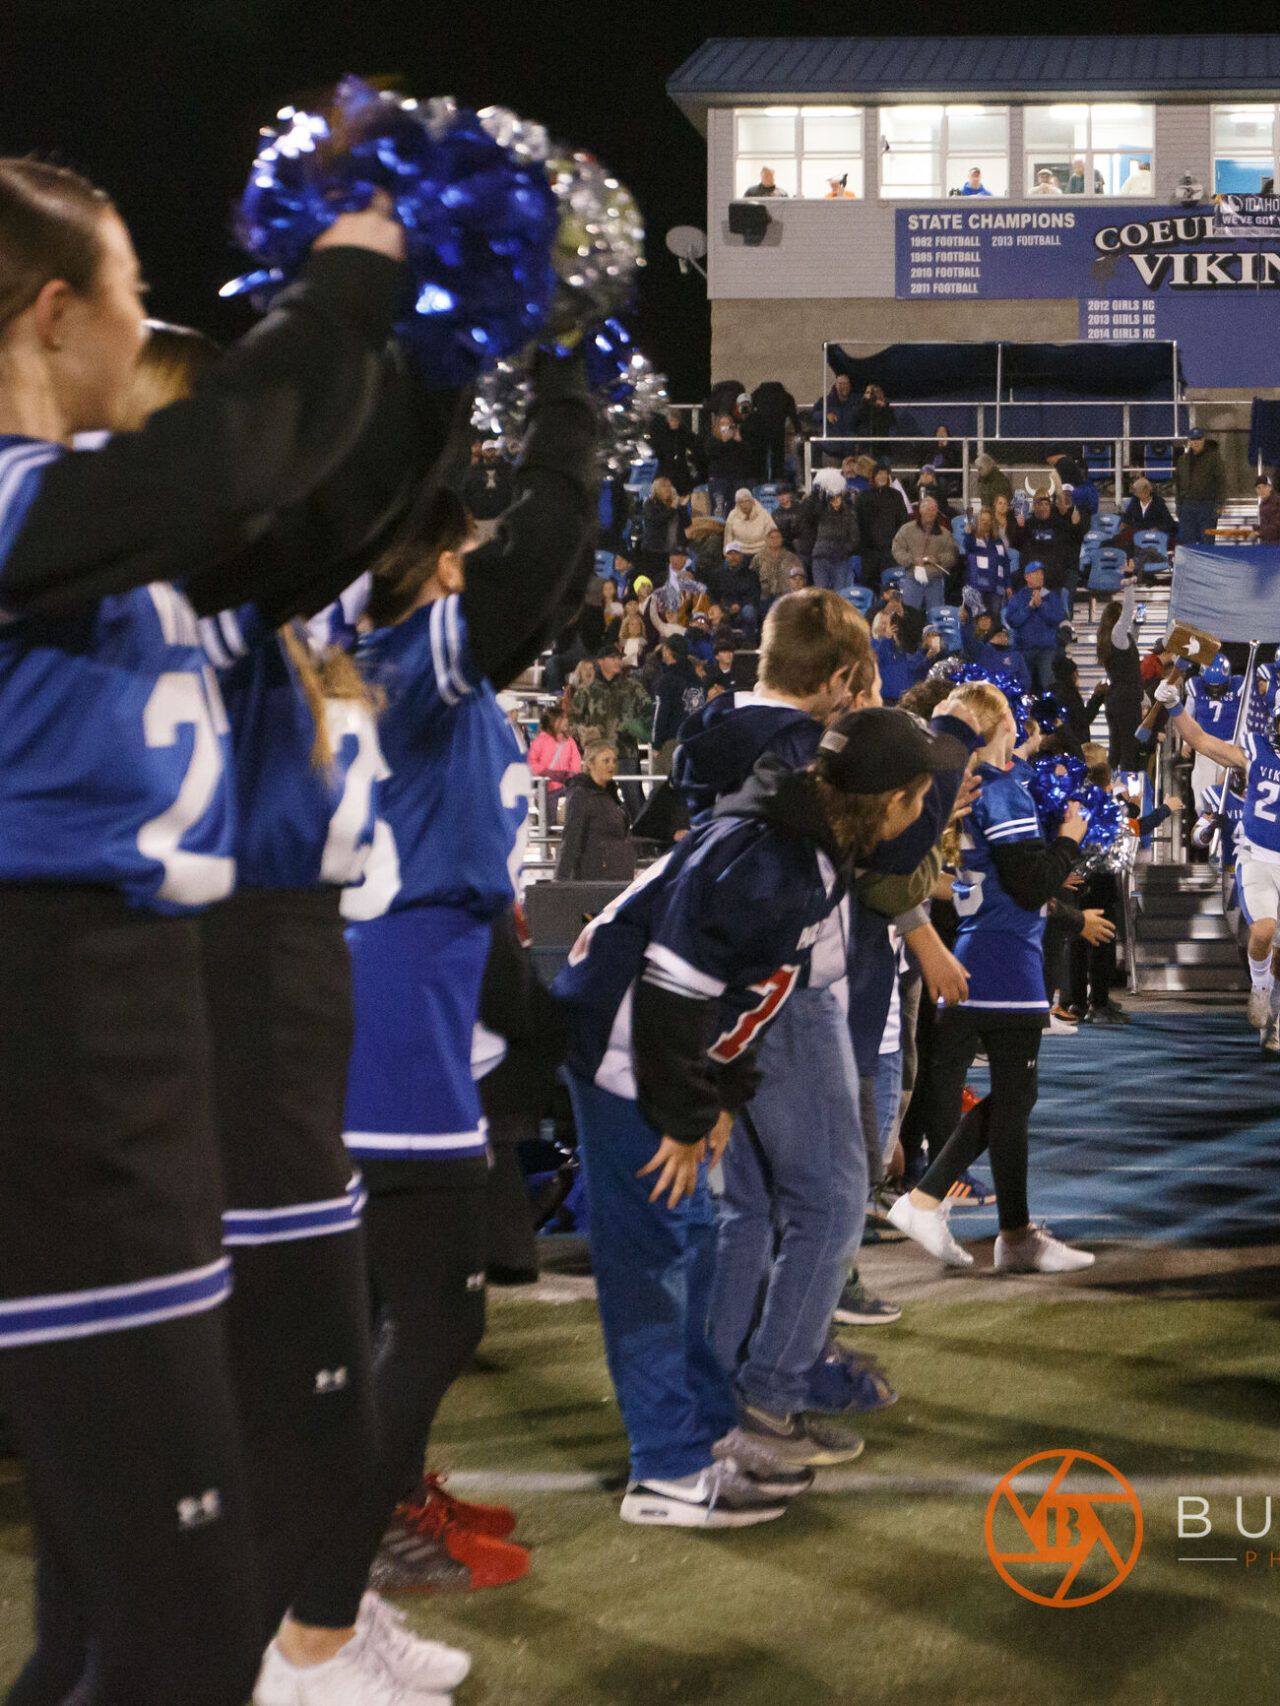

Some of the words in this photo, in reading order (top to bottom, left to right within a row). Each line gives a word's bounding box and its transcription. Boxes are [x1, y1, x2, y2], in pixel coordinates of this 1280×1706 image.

[908, 214, 963, 230] STATE
[968, 213, 1076, 229] CHAMPIONS
[1222, 214, 1252, 225] WE'VE
[1256, 215, 1275, 225] GOT
[935, 236, 981, 247] FOOTBALL
[992, 235, 1013, 247] 2013
[1017, 235, 1062, 246] FOOTBALL
[935, 252, 981, 262] FOOTBALL
[911, 267, 933, 278] 2010
[935, 267, 981, 278] FOOTBALL
[911, 283, 931, 294] 2011
[933, 283, 979, 294] FOOTBALL
[1088, 300, 1109, 311] 2012
[1112, 300, 1139, 310] GIRLS
[1142, 300, 1155, 310] XC
[1088, 314, 1109, 325] 2013
[1112, 314, 1139, 325] GIRLS
[1142, 314, 1155, 325] XC
[1088, 328, 1109, 339] 2014
[1112, 328, 1139, 339] GIRLS
[1142, 328, 1155, 339] XC
[1209, 701, 1223, 722] 7
